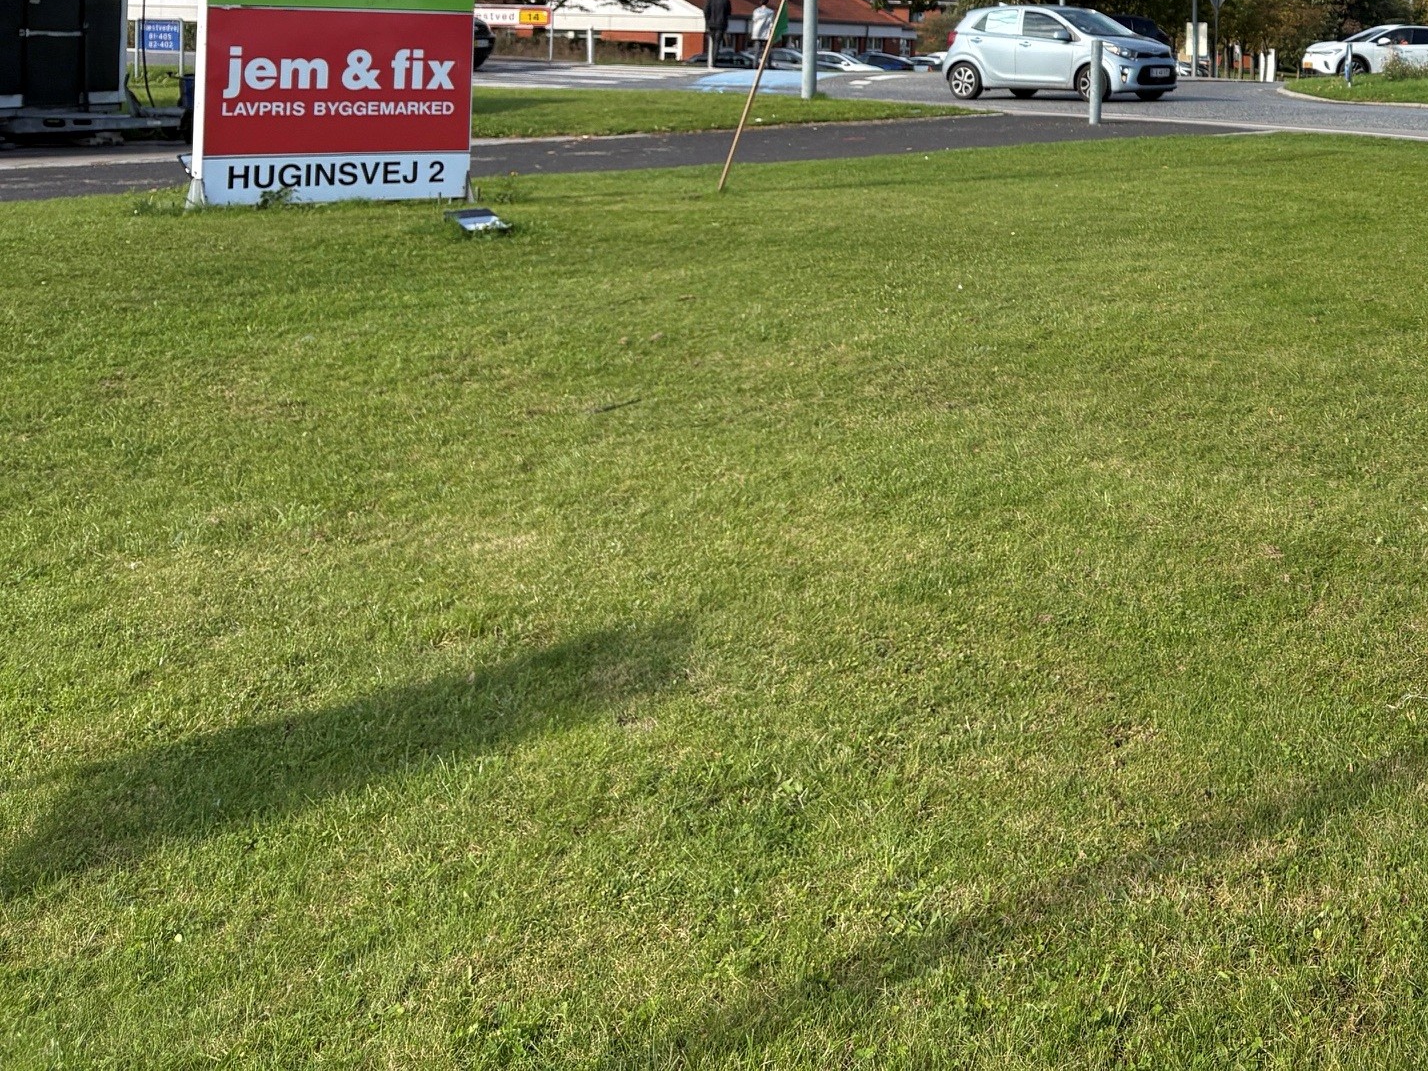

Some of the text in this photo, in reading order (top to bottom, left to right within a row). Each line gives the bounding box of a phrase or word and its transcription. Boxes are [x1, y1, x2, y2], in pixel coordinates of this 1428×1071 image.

[222, 45, 456, 99] jem & fix
[221, 100, 455, 118] LAVPRIS BYGGEMARKED
[227, 160, 445, 190] HUGINSVEJ 2
